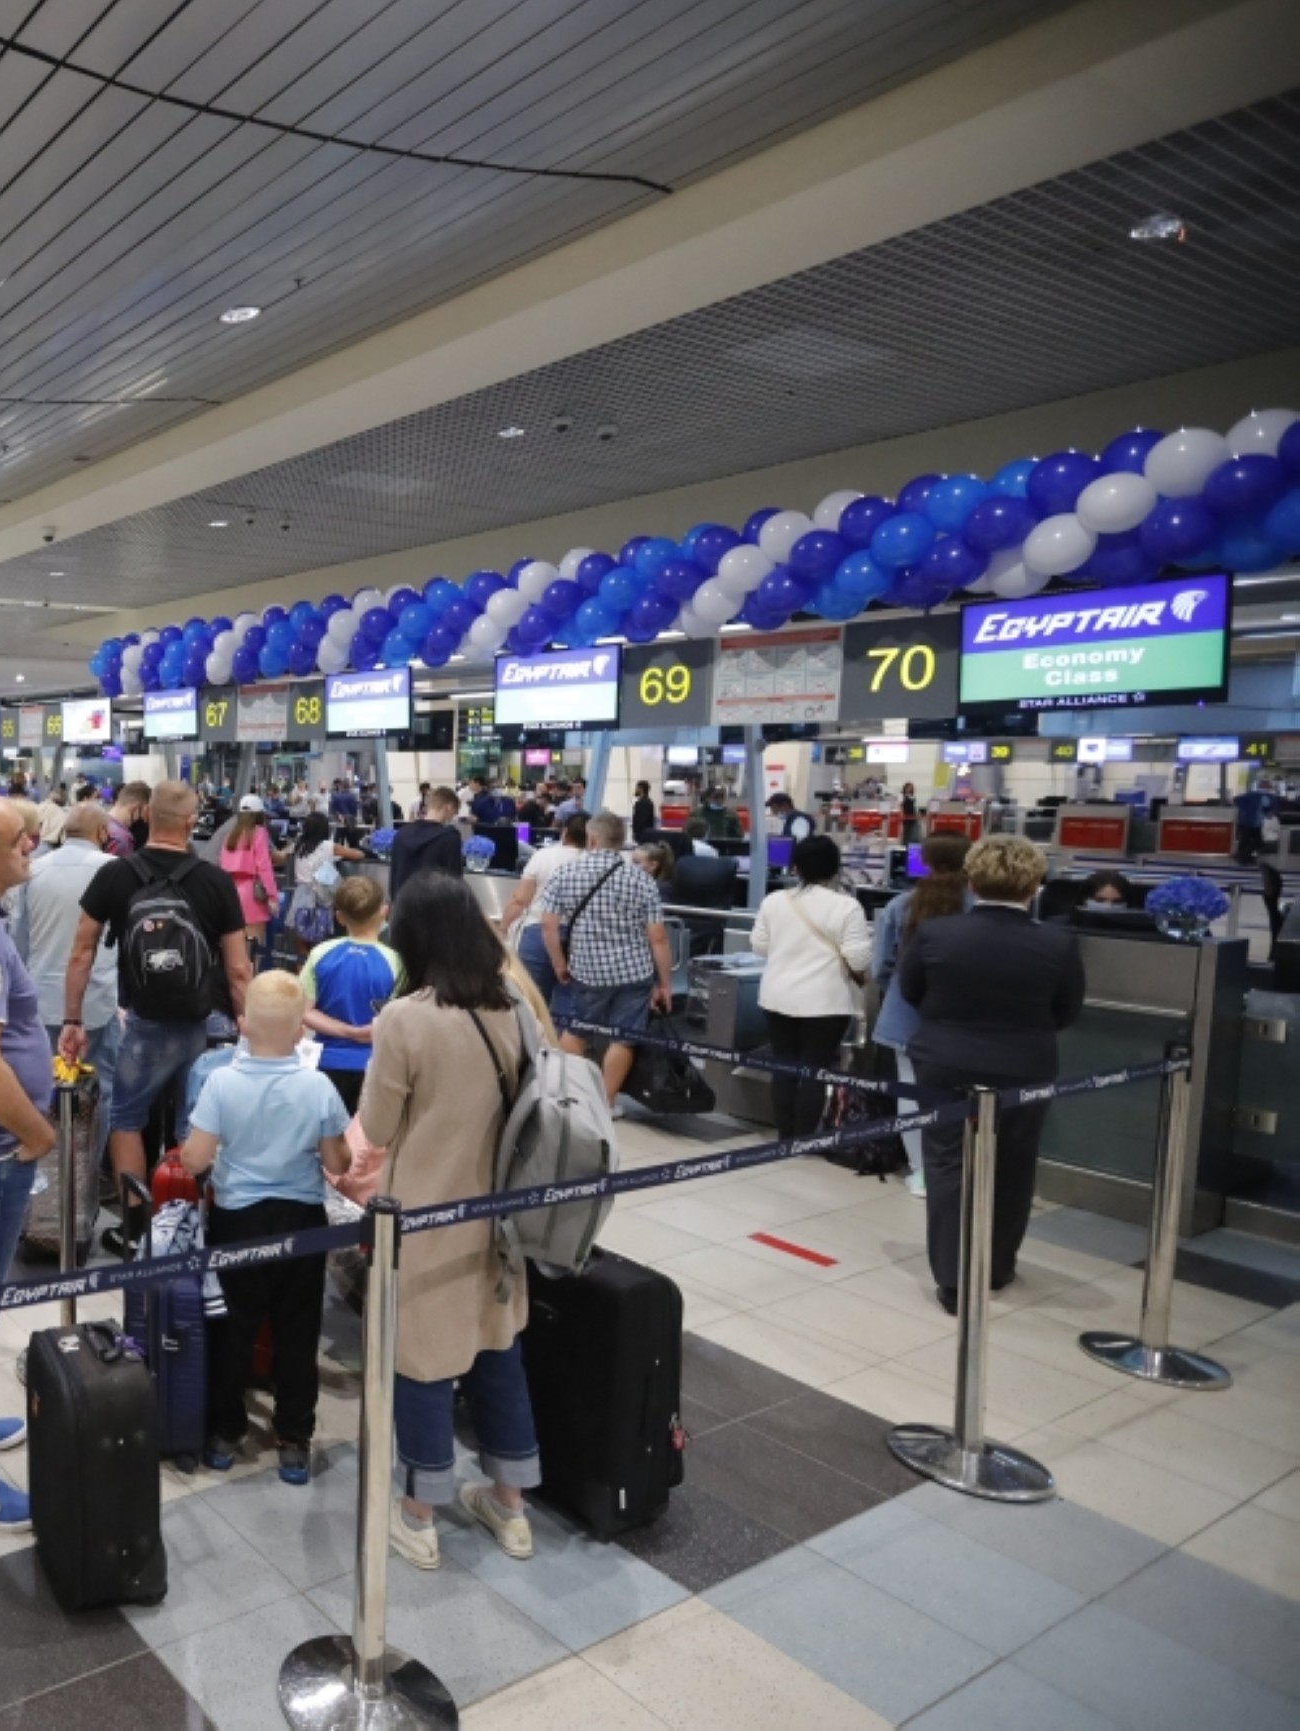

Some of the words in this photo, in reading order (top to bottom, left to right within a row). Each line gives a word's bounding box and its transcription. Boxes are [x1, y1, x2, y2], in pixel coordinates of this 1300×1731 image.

[973, 601, 1167, 643] EGYPTAIR
[866, 645, 936, 693] 70
[1021, 647, 1146, 670] Economy
[501, 661, 592, 684] EGYPTAIR
[1044, 668, 1119, 687] Class
[639, 665, 692, 706] 69
[295, 697, 321, 724] 68
[1019, 697, 1053, 709] STAR
[1056, 693, 1127, 707] ALLIANCE
[206, 701, 228, 727] 67
[1055, 743, 1075, 758] 40
[1245, 743, 1268, 756] 41
[0, 1278, 87, 1306] EGYPTAIR
[208, 1243, 282, 1269] EGYPTAIR
